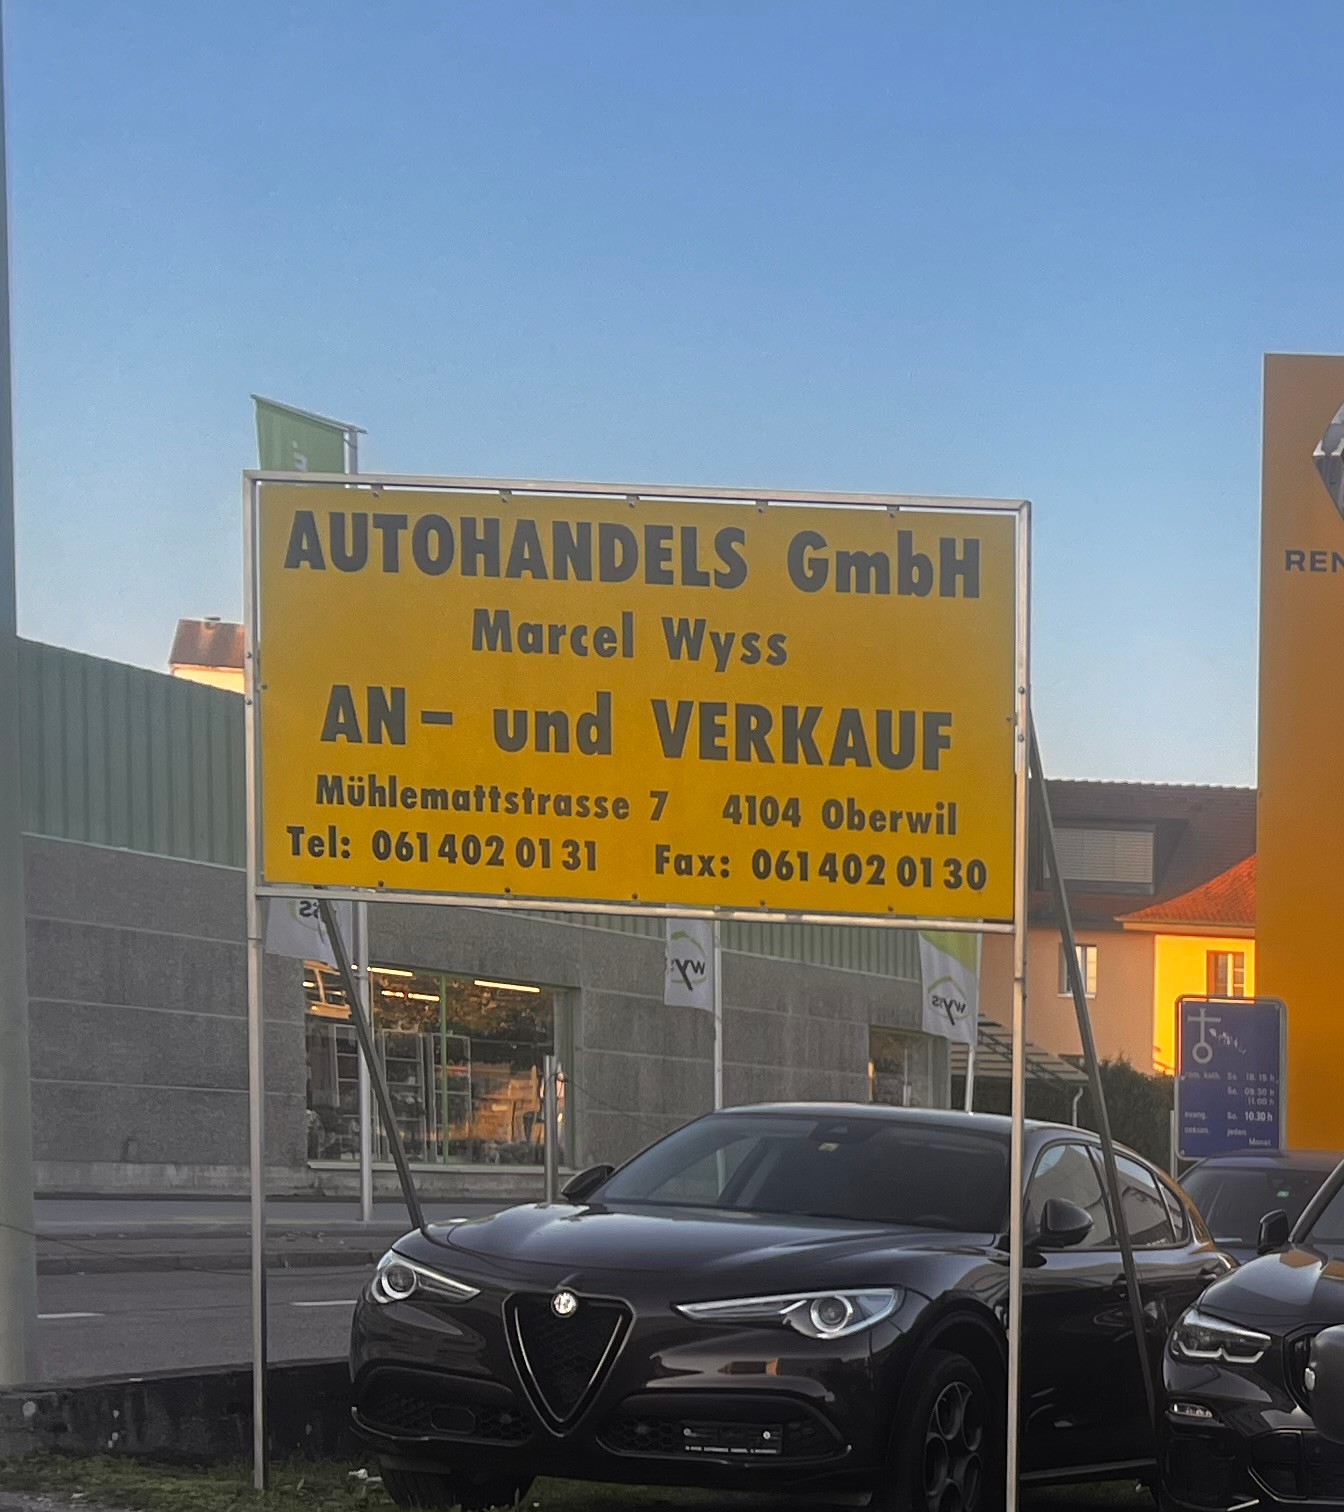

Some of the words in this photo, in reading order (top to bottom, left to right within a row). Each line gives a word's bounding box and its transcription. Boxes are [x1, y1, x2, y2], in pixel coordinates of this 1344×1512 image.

[283, 509, 749, 591] AUTOHANDELS
[786, 528, 981, 600] GmbH
[472, 608, 635, 660] Marcel
[661, 616, 789, 673] Wyss
[493, 692, 612, 756] und
[651, 699, 953, 771] VERKAUF
[316, 775, 630, 821] Mühlemattstrasse
[650, 791, 669, 822] 7
[722, 794, 801, 828] 4104
[821, 798, 957, 835] Oberwil
[286, 825, 350, 859] Tel:
[654, 844, 730, 878] Fax:
